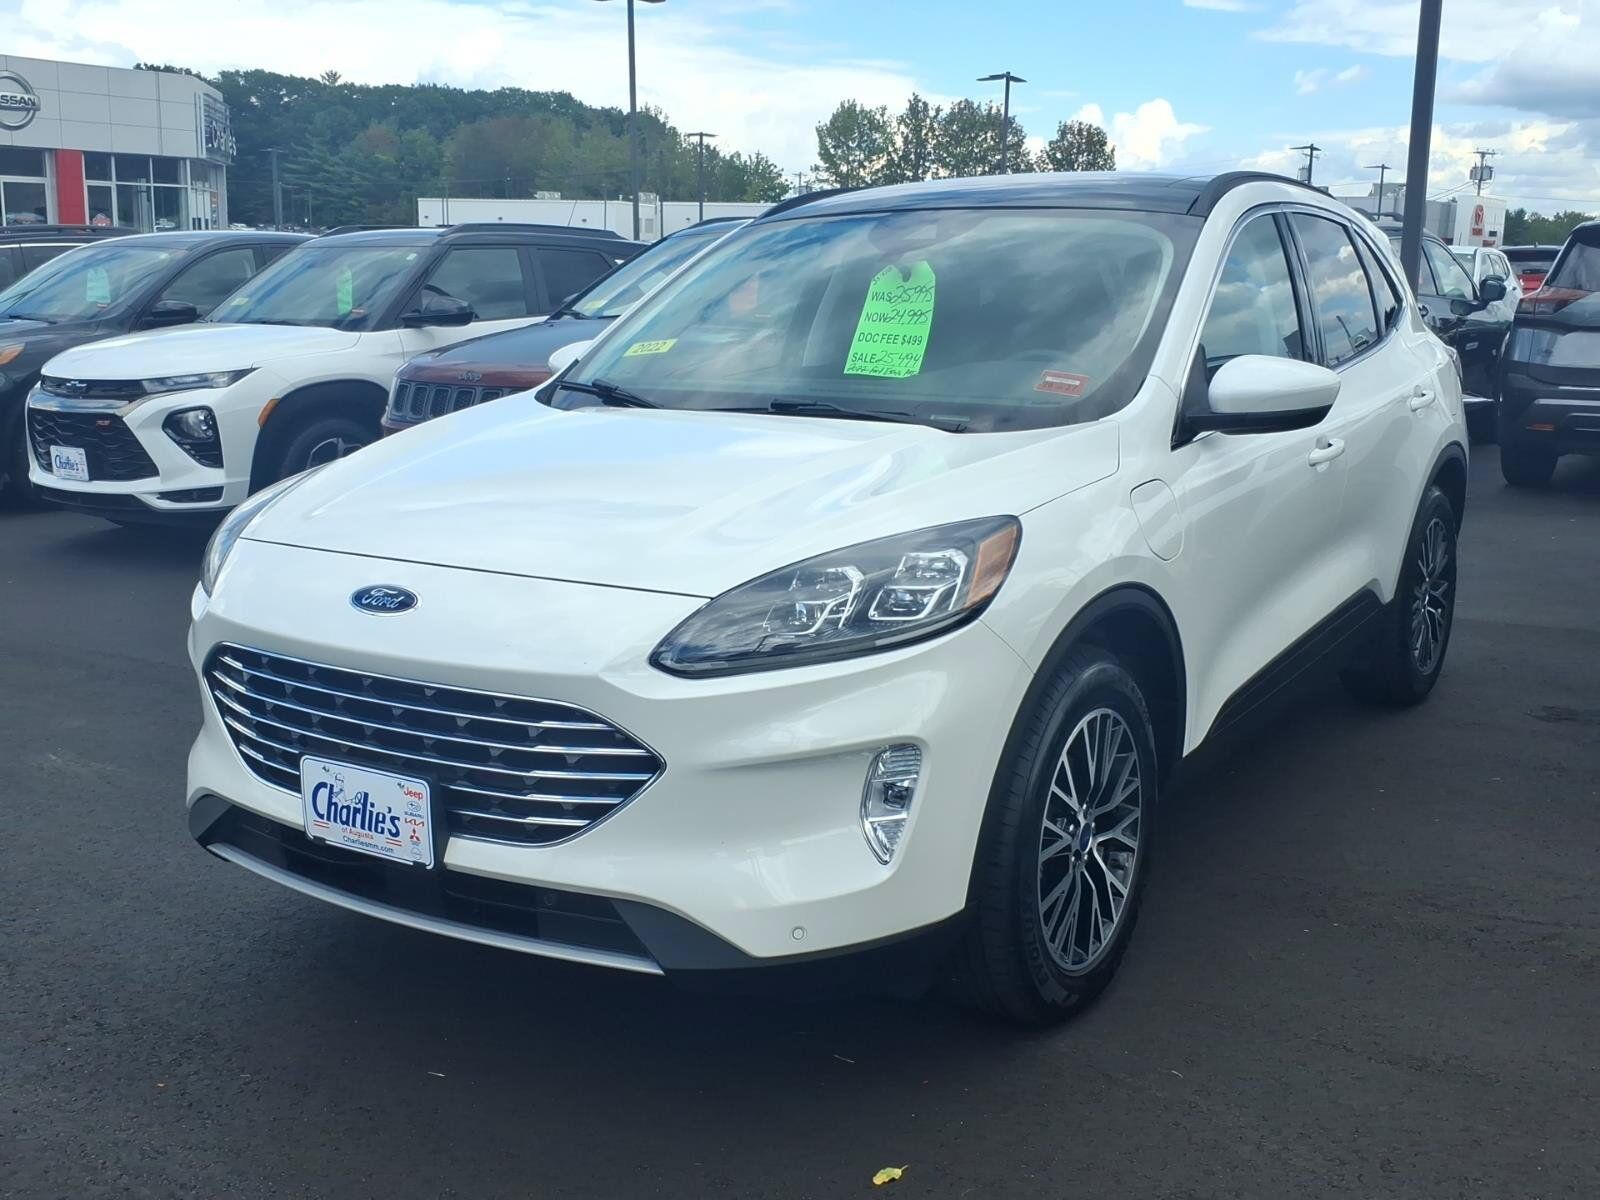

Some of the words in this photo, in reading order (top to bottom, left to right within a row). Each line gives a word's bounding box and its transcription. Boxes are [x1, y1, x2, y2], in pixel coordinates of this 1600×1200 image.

[0, 94, 36, 106] SSAN
[871, 291, 892, 302] WAS
[864, 311, 888, 322] NOW
[857, 332, 880, 344] DOC
[880, 333, 900, 345] FEE
[900, 334, 923, 346] $499
[631, 341, 668, 353] 2022
[851, 352, 877, 363] SALE
[361, 588, 404, 608] Ford
[403, 787, 424, 800] Jeep
[312, 781, 400, 837] Charlie's
